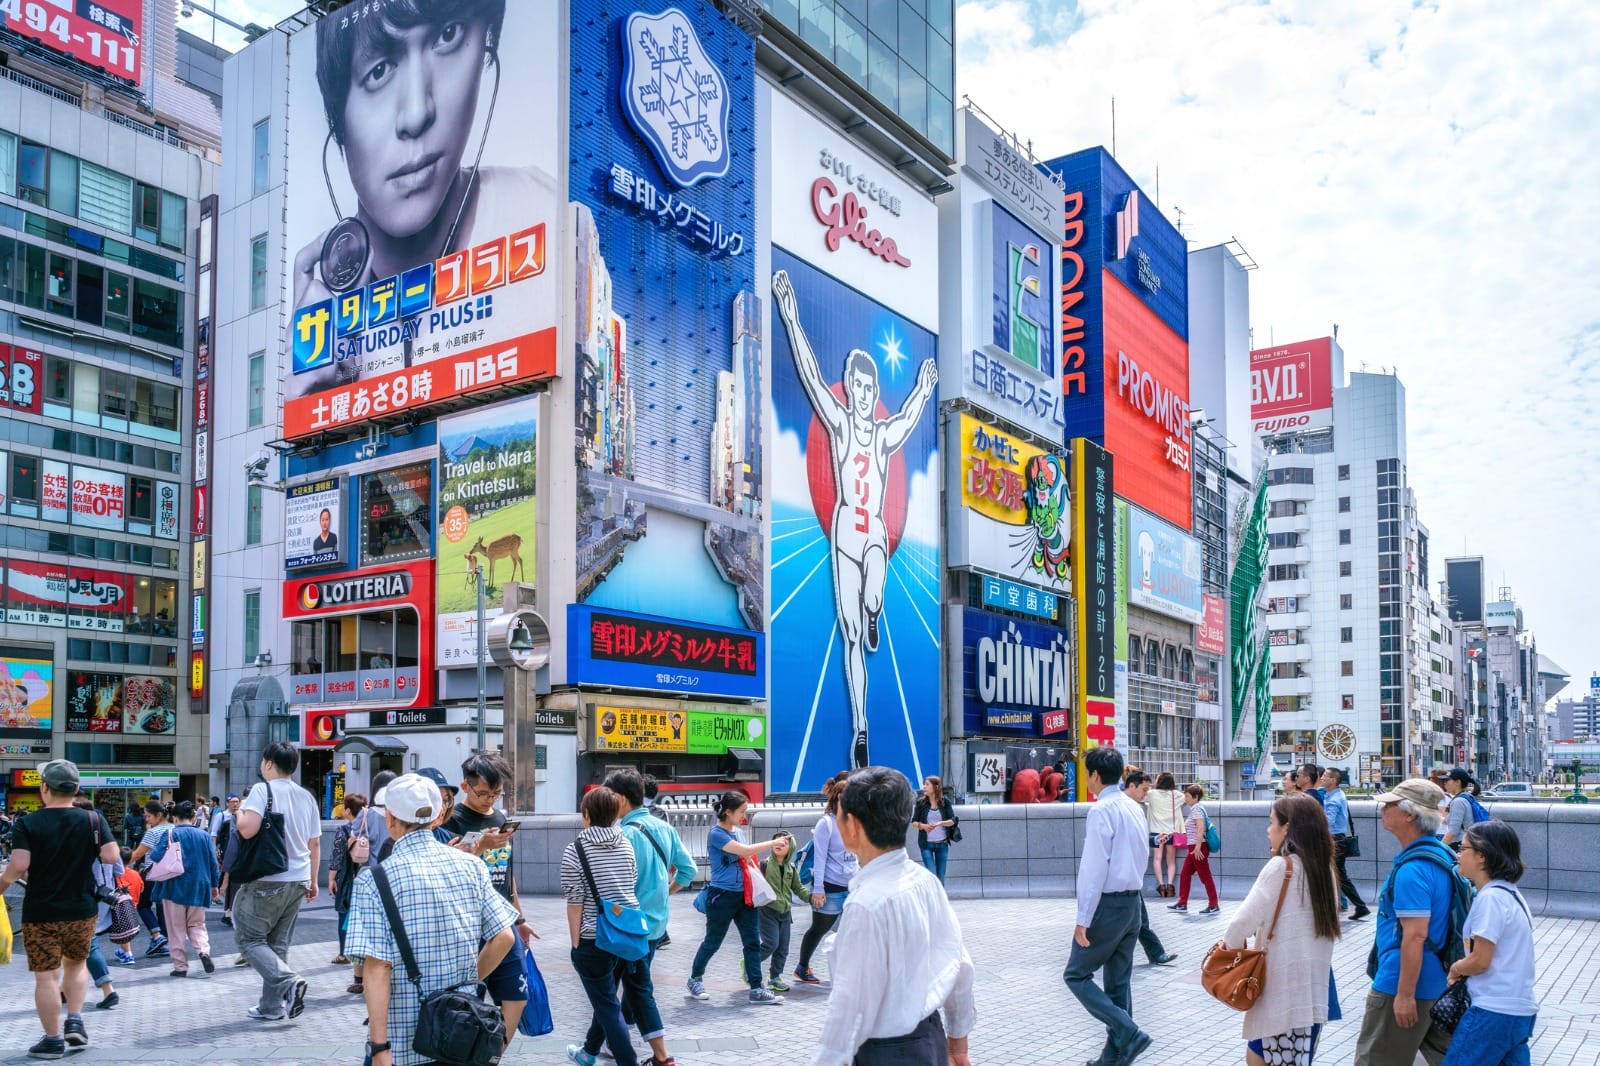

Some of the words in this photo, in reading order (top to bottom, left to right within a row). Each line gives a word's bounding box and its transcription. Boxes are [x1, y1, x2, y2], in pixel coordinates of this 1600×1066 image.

[89, 5, 121, 31] 検索
[0, 0, 135, 72] 494-111
[993, 138, 1043, 193] 夢ある住まい
[820, 148, 901, 218] おいしさと健康
[984, 158, 1051, 225] エステムシリーズ
[611, 162, 743, 256] 雪印メグミルク
[811, 177, 911, 268] Glico
[297, 234, 539, 364] サタデープラス
[1138, 270, 1158, 296] FINANCE
[337, 316, 422, 362] SATURDAY
[430, 301, 474, 333] PLUS
[311, 370, 432, 429] 土曜あさ8時
[972, 349, 1067, 428] 日商エステム
[1118, 350, 1190, 445] PROMISE
[1250, 364, 1303, 406] B.V.D.
[1254, 416, 1310, 432] FUJIBO
[974, 426, 1020, 465] かぜに
[1165, 436, 1190, 473] プロミス
[444, 456, 483, 479] Travel
[487, 461, 496, 471] to
[498, 450, 532, 469] Nara
[443, 492, 460, 502] on
[457, 477, 519, 499] Kintetsu.
[853, 451, 871, 534] グリコ
[967, 455, 1025, 513] 改源
[92, 497, 123, 518] 0円
[449, 518, 462, 532] 35
[69, 577, 119, 606] 風月
[323, 575, 404, 603] LOTTERIA
[25, 613, 35, 622] 11
[39, 614, 49, 623] 時
[85, 619, 93, 627] 2
[97, 620, 107, 628] 時
[592, 620, 756, 672] 雪印メグミルク牛乳
[656, 673, 699, 686] 雪印メグミルク
[106, 721, 120, 731] 2F
[398, 712, 427, 723] Toilets
[536, 712, 565, 724] Toilets
[714, 717, 746, 741] ピタットハウス
[1053, 714, 1065, 729] 検索
[106, 778, 145, 786] FamilyMart
